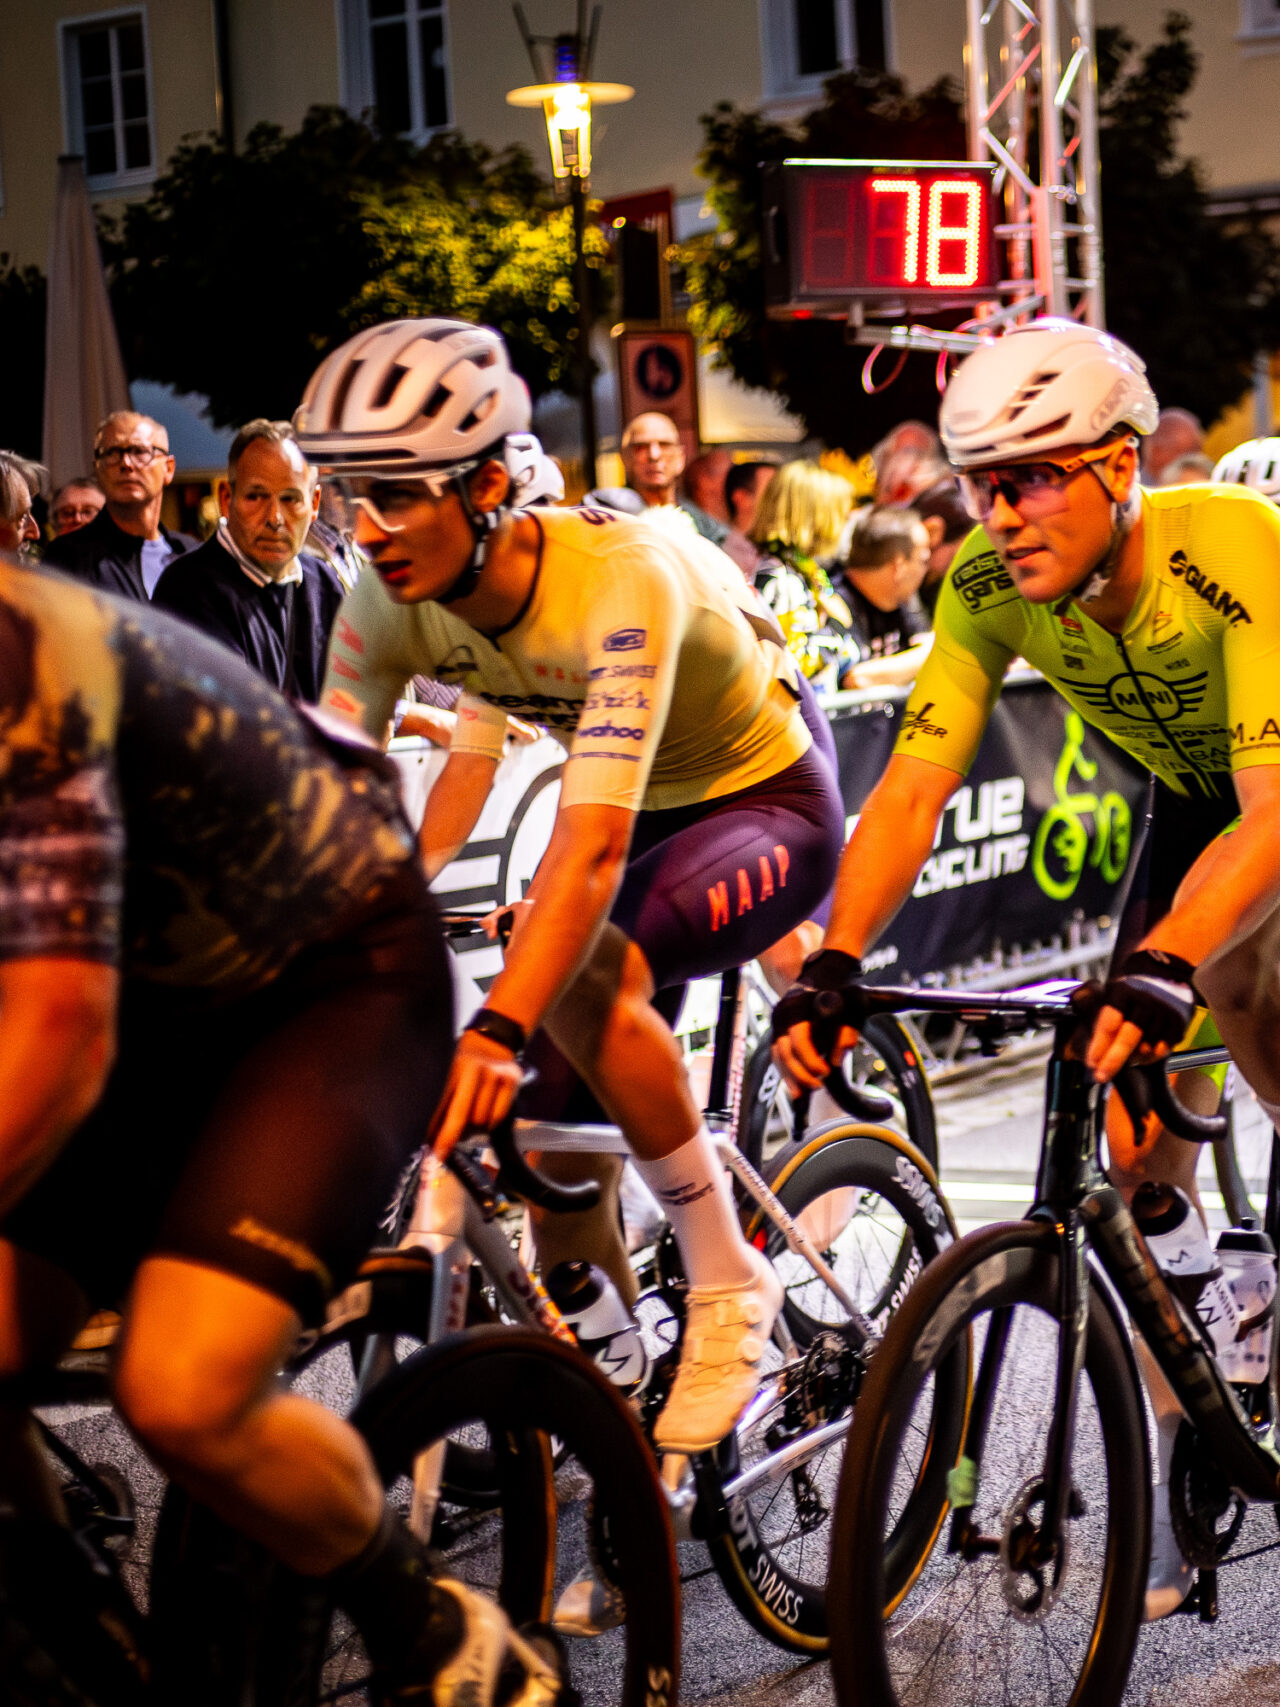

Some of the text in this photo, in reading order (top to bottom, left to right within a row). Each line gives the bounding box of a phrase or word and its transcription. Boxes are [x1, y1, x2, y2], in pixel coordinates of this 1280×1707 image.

[872, 179, 982, 286] 78
[1185, 564, 1253, 625] GIANT
[1115, 690, 1173, 707] MNI
[707, 844, 790, 932] MAAP
[749, 1553, 804, 1626] SWISS
